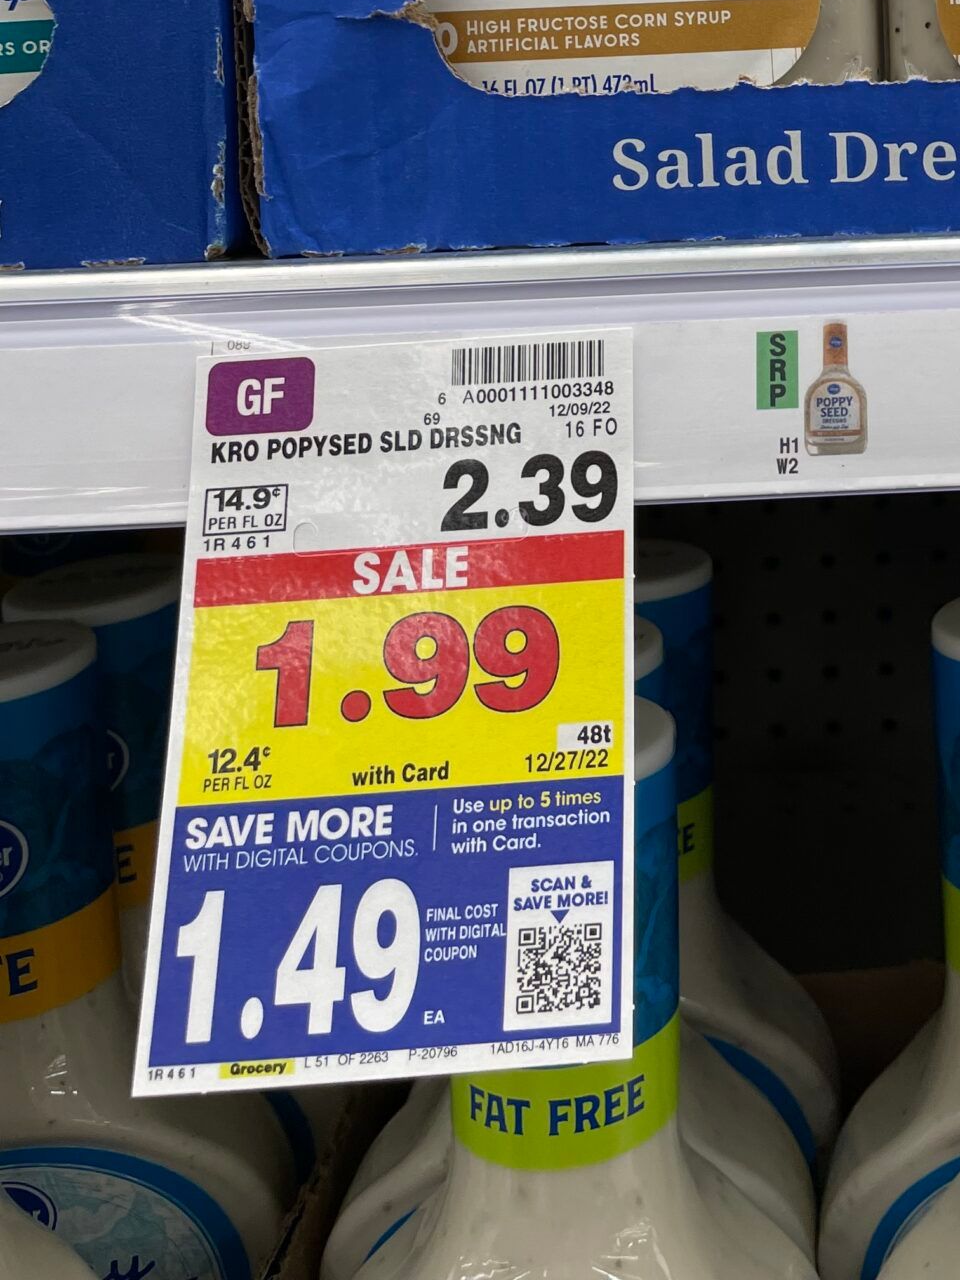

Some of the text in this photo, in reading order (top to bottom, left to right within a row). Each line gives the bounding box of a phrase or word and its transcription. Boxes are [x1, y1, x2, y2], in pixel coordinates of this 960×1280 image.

[466, 9, 732, 36] HIGH FRUCTOSE CORN SYRUP
[467, 32, 641, 54] ARTIFICIAL FLAVORS
[611, 131, 809, 193] Salad
[236, 377, 285, 417] GF
[437, 380, 614, 406] 6 A0001111003348
[816, 396, 854, 408] POPPY
[423, 412, 441, 426] 69
[549, 400, 611, 418] 12/09/22
[820, 407, 849, 418] SEED
[565, 420, 585, 439] 16
[210, 422, 522, 465] KRO POPYSED SLD DRSSNG
[780, 437, 799, 454] H1
[776, 458, 799, 475] W2
[440, 449, 619, 532] 2.39
[208, 513, 283, 531] PER FL OZ
[352, 546, 470, 595] SALE
[255, 605, 560, 728] 1.99
[577, 724, 613, 745] 48t
[524, 751, 610, 773] 12/27/22
[203, 773, 272, 792] PER FL OZ
[352, 760, 450, 787] with Card
[452, 790, 602, 814] Use up to 5 times
[185, 804, 394, 851] SAVE MORE
[452, 809, 611, 834] in one transaction
[451, 833, 542, 854] with Card.
[183, 839, 420, 873] WITH DIGITAL COUPONS.
[531, 874, 592, 892] SCAN &
[513, 891, 609, 912] SAVE MORE!
[426, 904, 499, 922] FINAL COST
[425, 924, 507, 943] WITH DIGITAL
[176, 877, 422, 1045] 1.49
[424, 945, 478, 963] COUPON
[423, 1010, 446, 1025] EA
[575, 1035, 595, 1048] MA
[599, 1033, 620, 1046] 776
[303, 1051, 389, 1069] L 51 OF 2263
[408, 1046, 459, 1061] P-20796
[229, 1060, 287, 1077] Grocery
[469, 1074, 646, 1137] FAT FREE
